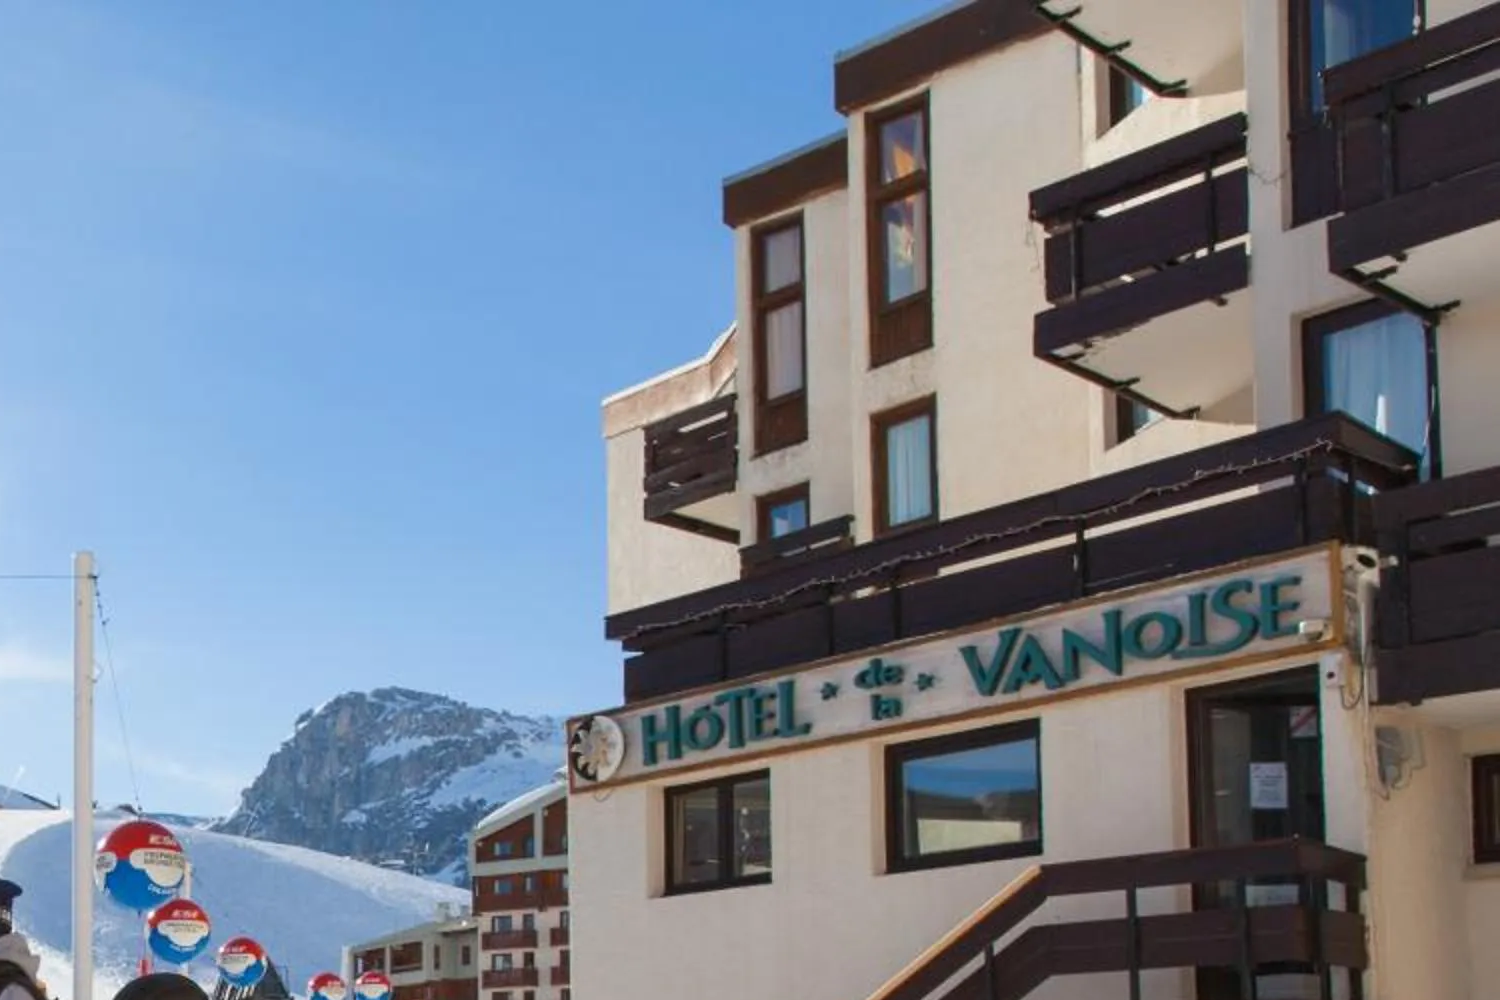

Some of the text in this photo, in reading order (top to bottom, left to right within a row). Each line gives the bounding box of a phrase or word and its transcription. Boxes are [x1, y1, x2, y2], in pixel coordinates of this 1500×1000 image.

[958, 575, 1302, 697] VANOISE
[854, 658, 905, 689] de
[870, 693, 904, 721] la
